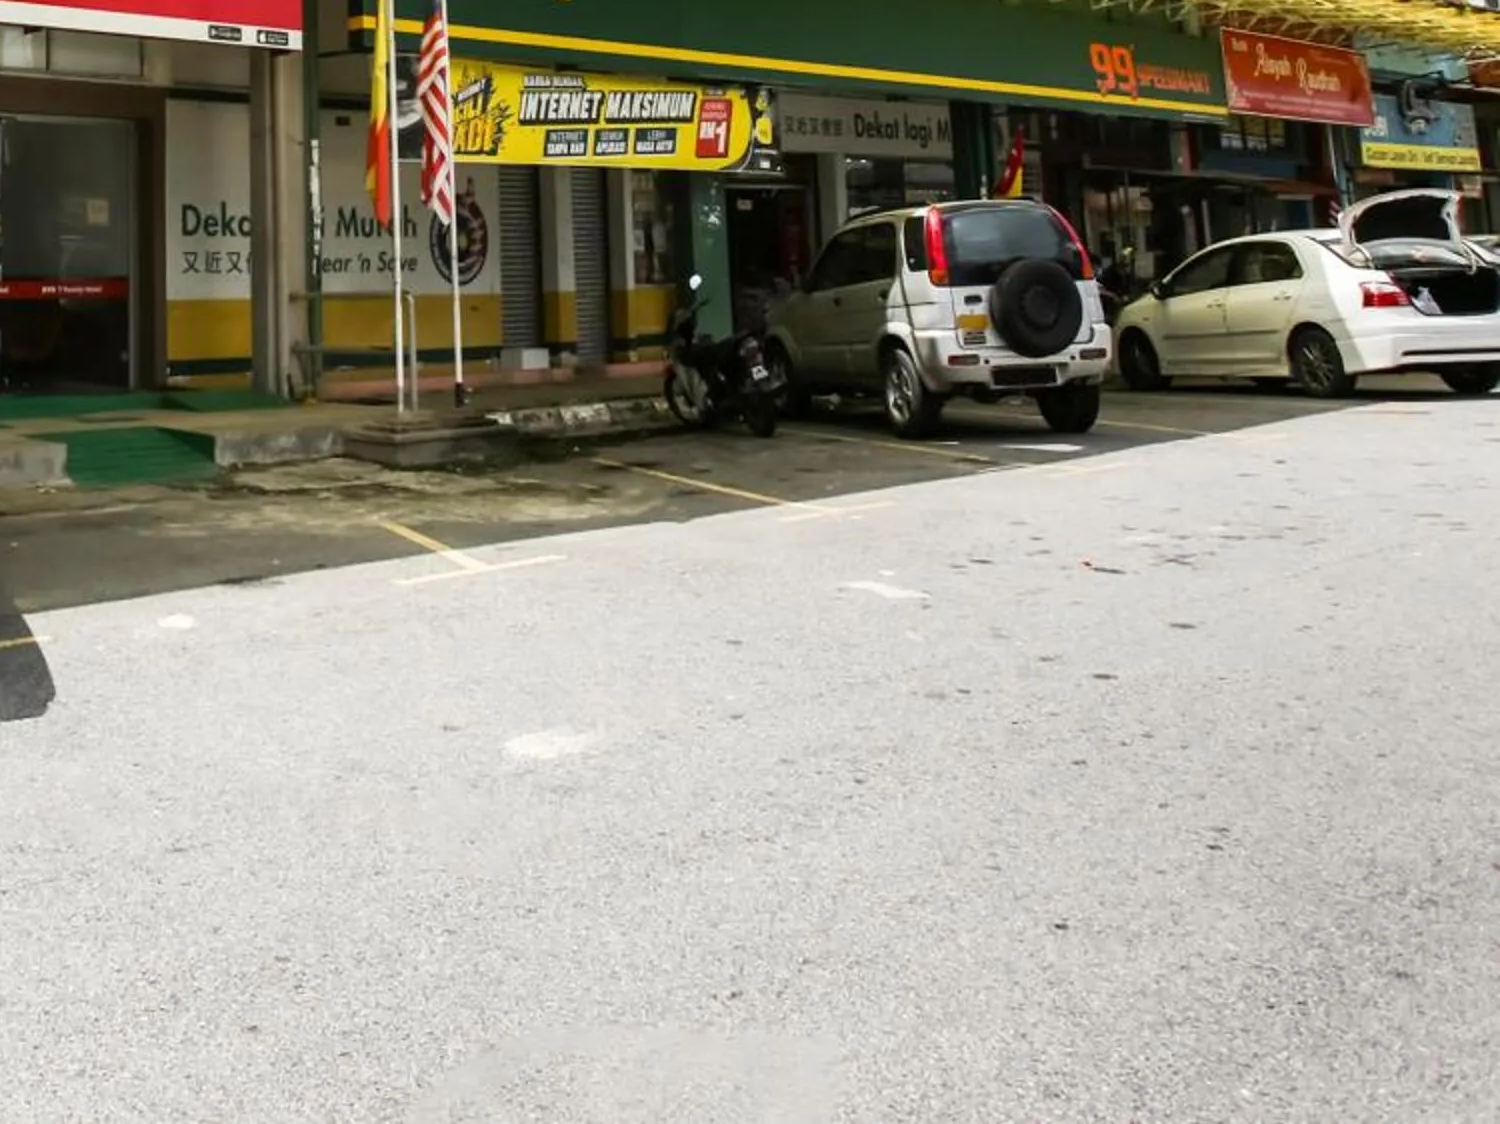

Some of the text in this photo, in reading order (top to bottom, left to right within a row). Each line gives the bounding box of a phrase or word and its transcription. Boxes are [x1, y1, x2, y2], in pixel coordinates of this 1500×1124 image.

[1090, 44, 1138, 100] 99
[519, 92, 602, 122] INTERNET
[606, 92, 695, 122] MAKSIMUM
[854, 111, 900, 140] Dekat
[904, 113, 933, 149] lagi
